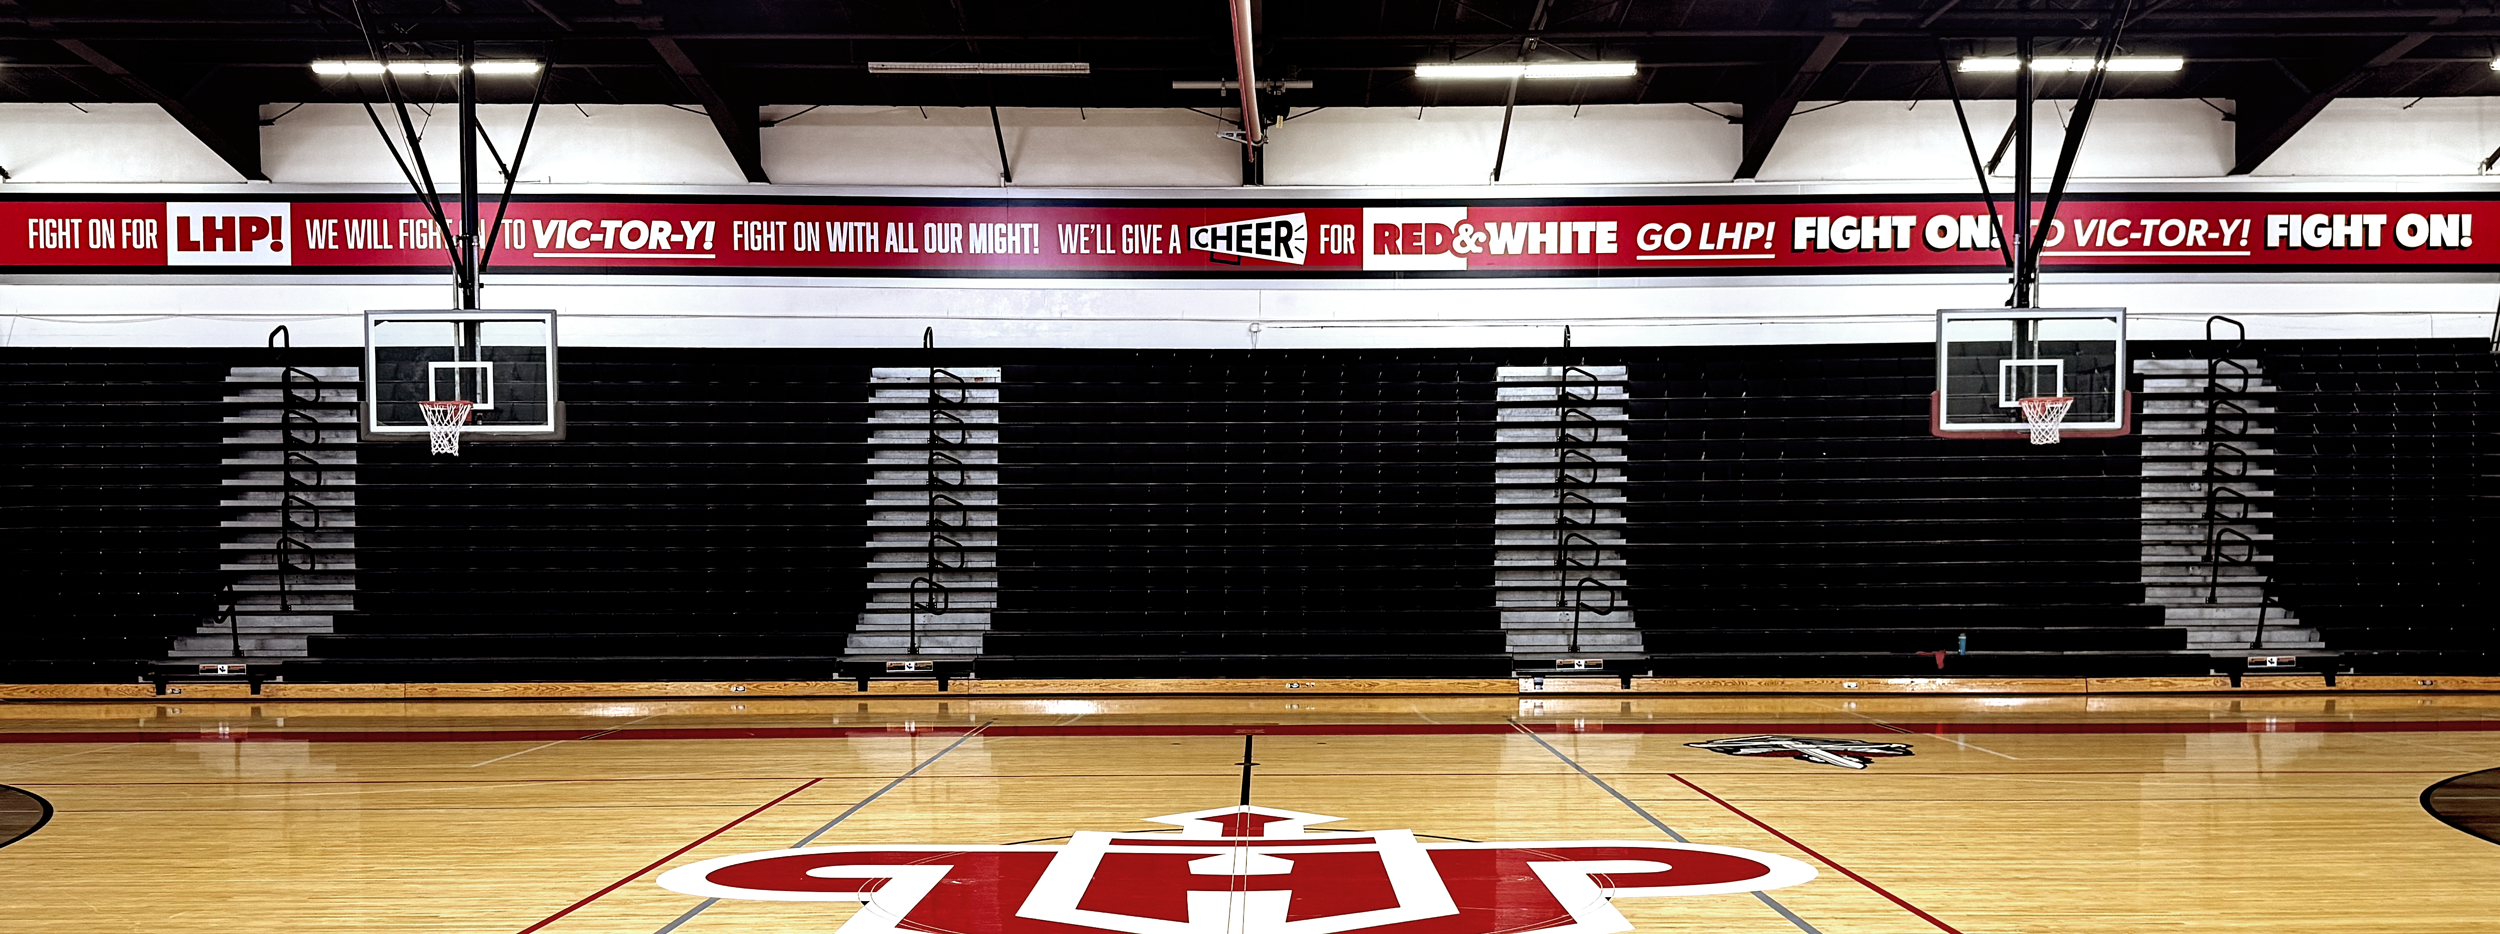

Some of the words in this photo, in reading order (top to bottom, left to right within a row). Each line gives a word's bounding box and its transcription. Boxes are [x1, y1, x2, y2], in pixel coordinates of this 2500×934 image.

[28, 218, 82, 249] FIGHT
[89, 218, 115, 249] ON
[121, 218, 158, 249] FOR
[176, 215, 284, 252] LHP!
[305, 218, 338, 249] WE
[344, 218, 393, 249] WILL
[501, 219, 526, 249] TO
[532, 219, 716, 250] VIC-TOR-Y!
[733, 220, 787, 251] FIGHT
[793, 221, 819, 251] ON
[826, 221, 880, 252] WITH
[885, 222, 918, 253] ALL
[924, 222, 963, 253] OUR
[969, 223, 1039, 254] MIGHT!
[1057, 224, 1116, 254] WE'LL
[1121, 224, 1163, 254] GIVE
[1168, 224, 1182, 254] A
[1194, 219, 1295, 259] CHEER
[1319, 224, 1355, 254] FOR
[1373, 221, 1618, 257] RED&WHITE
[1636, 223, 1692, 251] GO
[1698, 221, 1776, 250] LHP!
[1793, 215, 1917, 251] FIGHT
[1923, 214, 2003, 250] ON!
[2030, 218, 2066, 247] O
[2074, 218, 2252, 247] VIC-TOR-Y!
[2265, 213, 2387, 249] FIGHT
[2394, 212, 2473, 249] ON!
